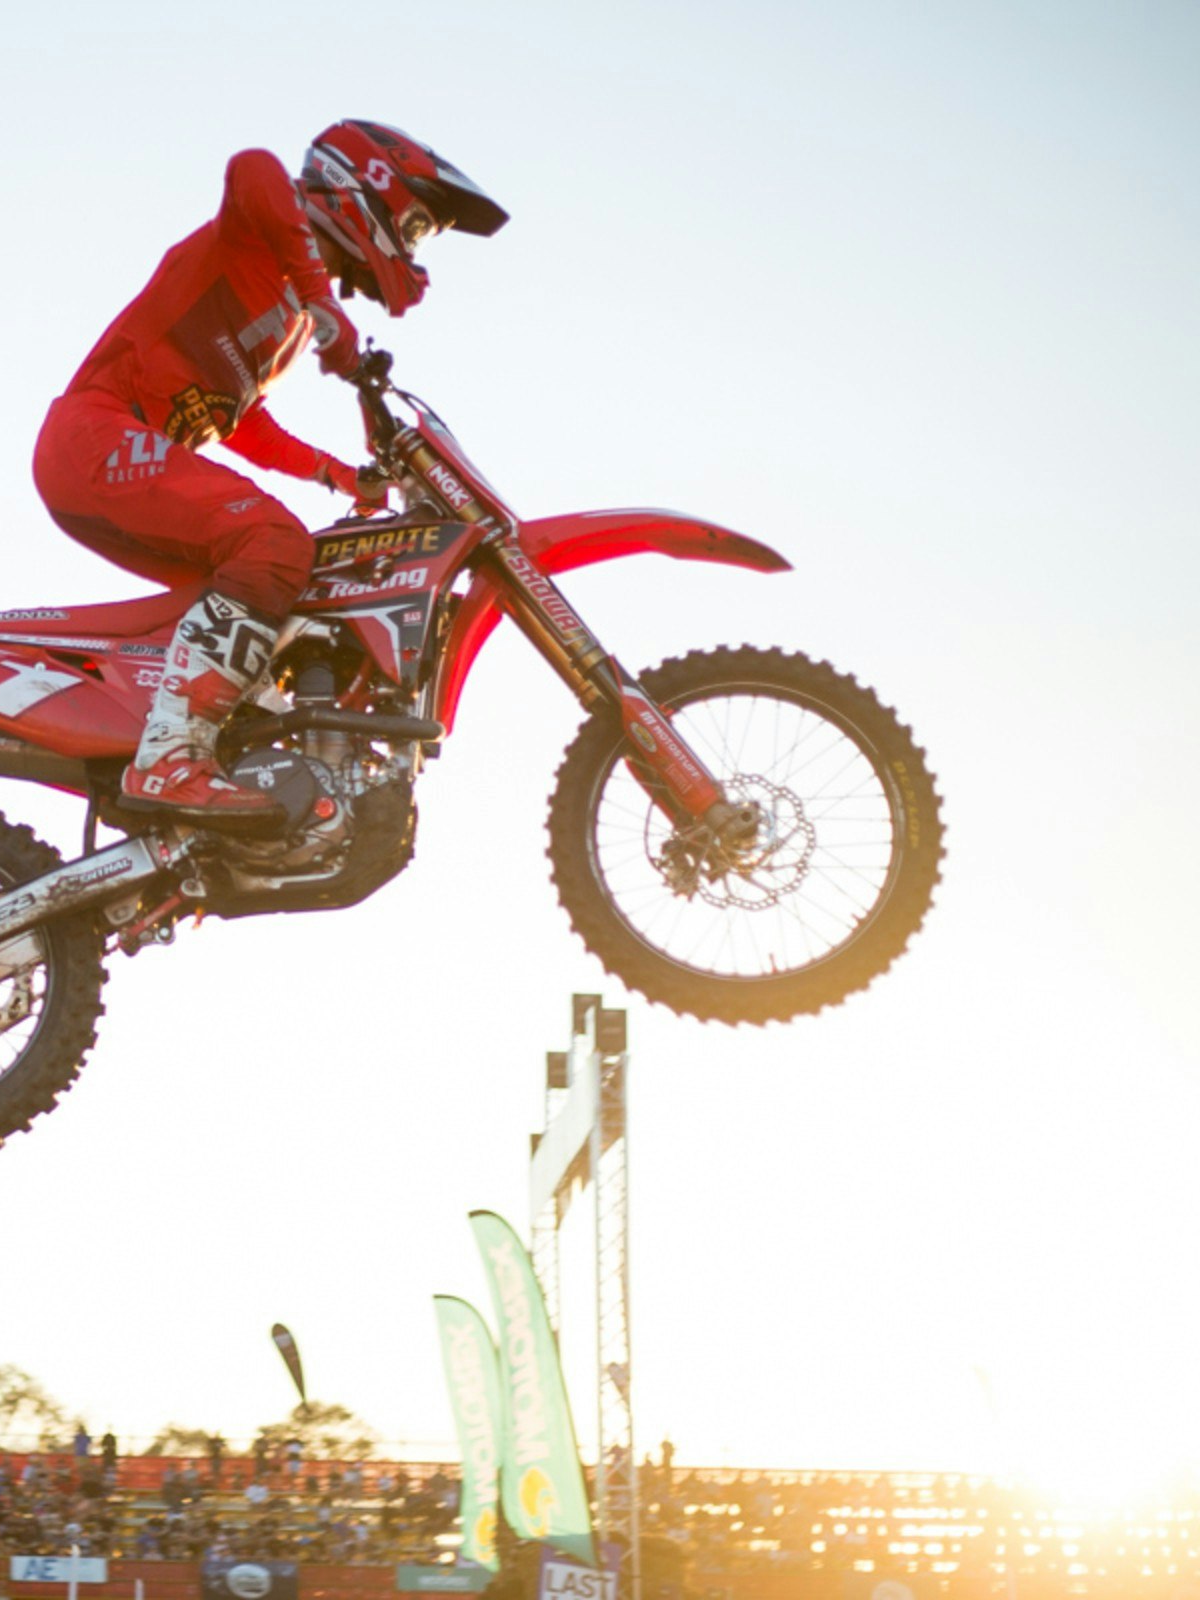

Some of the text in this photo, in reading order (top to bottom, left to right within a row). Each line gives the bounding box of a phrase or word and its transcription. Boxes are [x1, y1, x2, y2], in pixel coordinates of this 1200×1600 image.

[429, 465, 469, 507] NGK
[318, 526, 441, 565] PENRITE
[508, 557, 581, 631] SHOWA
[546, 1568, 612, 1599] LAST
